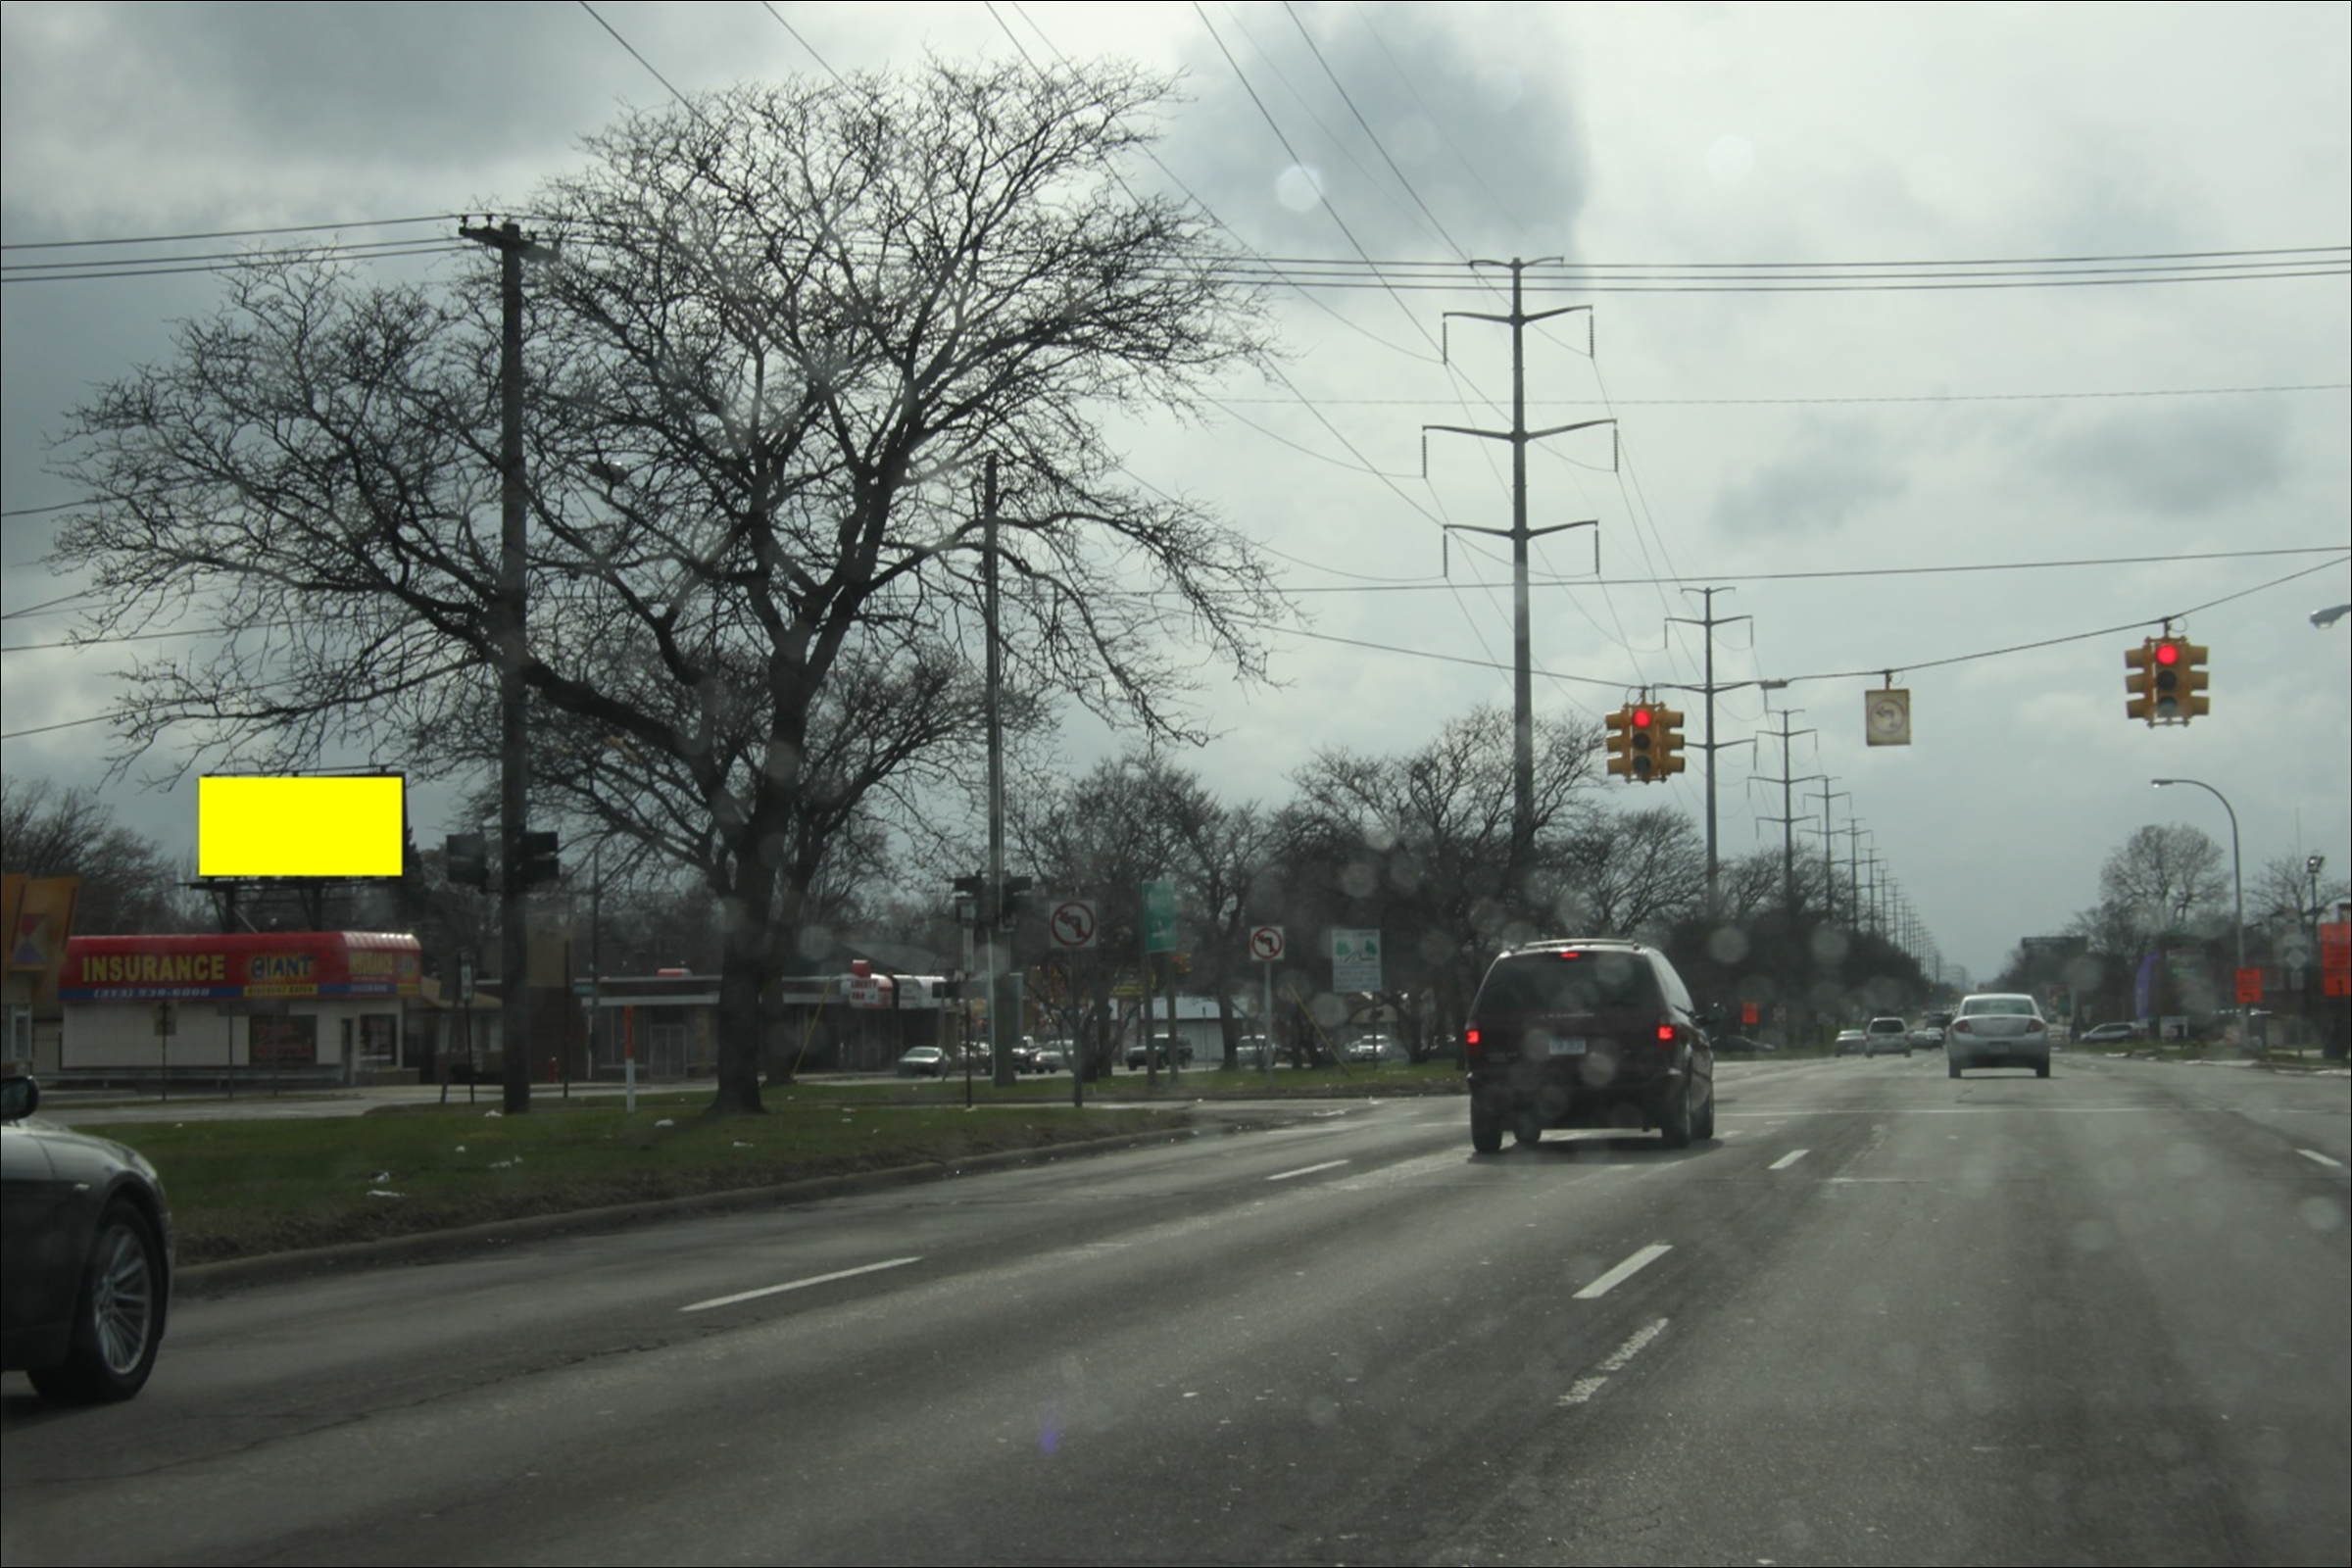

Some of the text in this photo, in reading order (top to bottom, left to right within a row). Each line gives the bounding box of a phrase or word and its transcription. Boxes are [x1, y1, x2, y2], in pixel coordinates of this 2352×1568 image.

[82, 954, 225, 983] INSURANCE
[250, 953, 318, 979] GIANT
[93, 987, 134, 999] (313)
